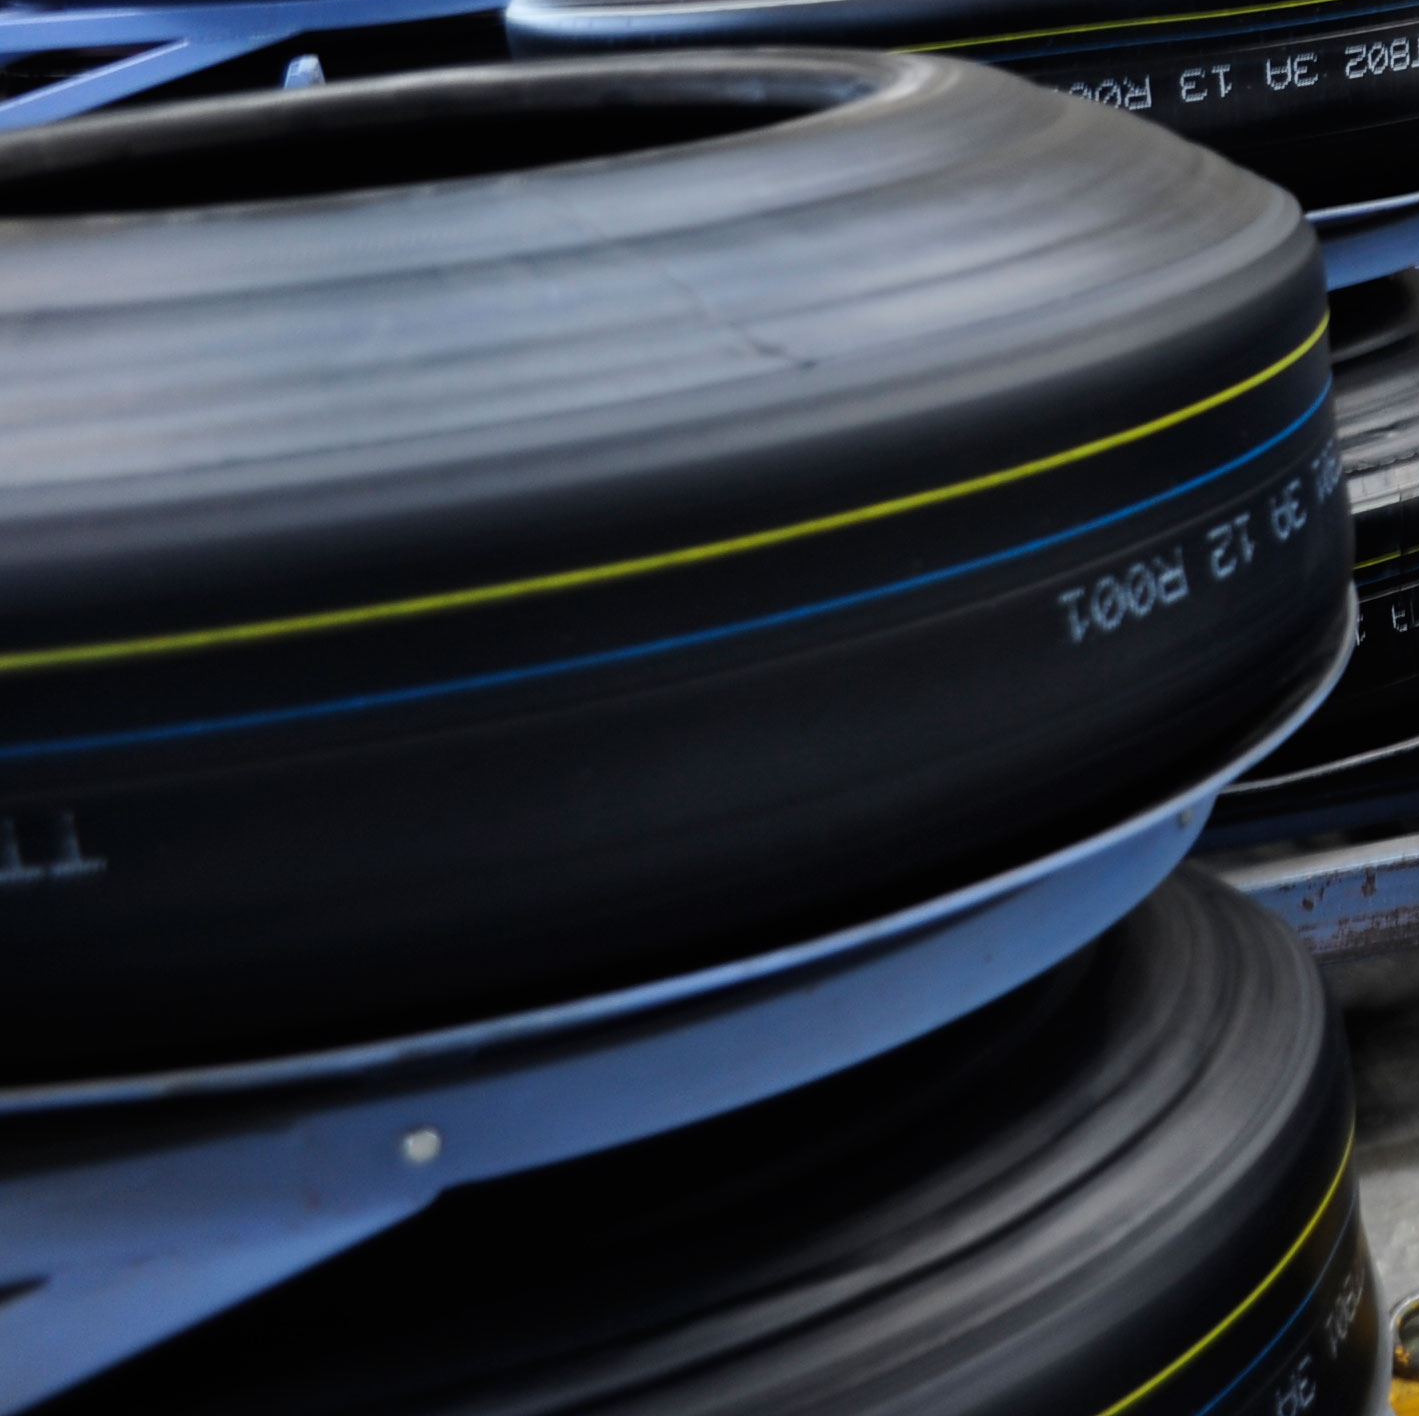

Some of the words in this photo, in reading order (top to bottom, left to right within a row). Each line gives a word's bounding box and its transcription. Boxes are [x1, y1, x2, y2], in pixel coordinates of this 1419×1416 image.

[1180, 63, 1232, 103] 13
[1266, 51, 1318, 90] 3A
[1206, 512, 1255, 579] 12
[1058, 544, 1190, 644] R001
